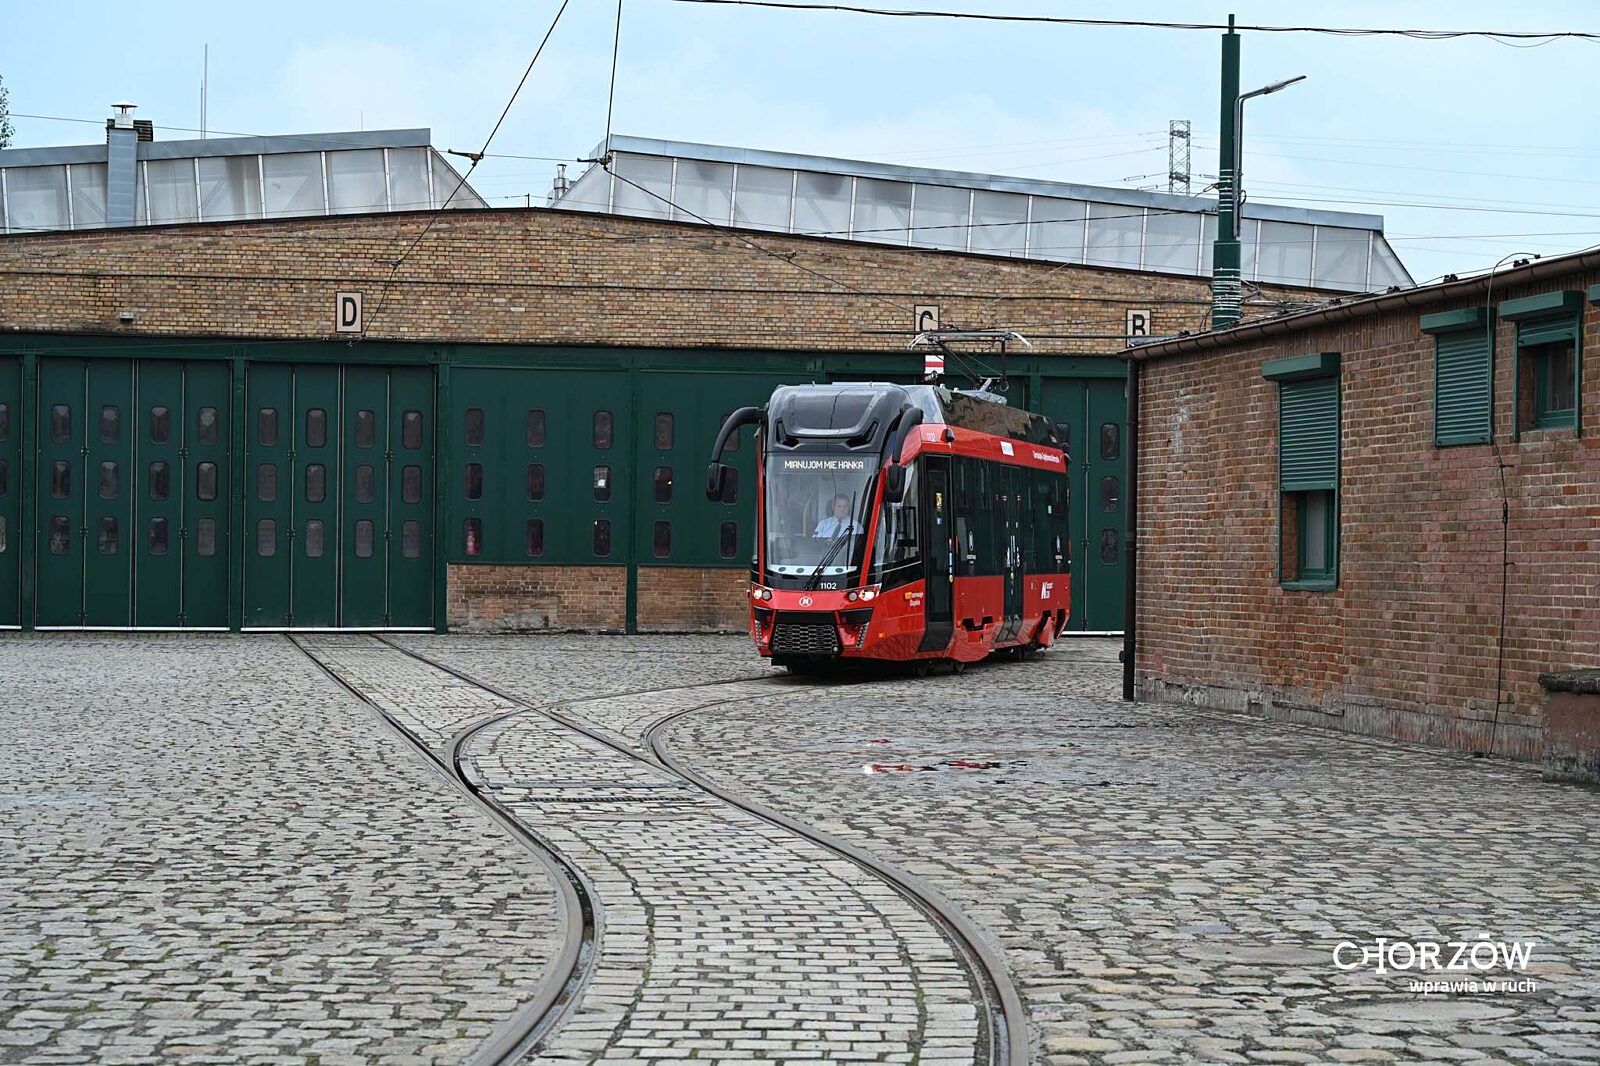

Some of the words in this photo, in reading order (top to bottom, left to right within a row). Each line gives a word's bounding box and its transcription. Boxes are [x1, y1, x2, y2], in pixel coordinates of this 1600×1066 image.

[342, 297, 357, 326] D
[784, 460, 823, 469] MIANUJOM
[824, 460, 837, 469] MIE
[838, 460, 864, 470] HANKA
[820, 582, 837, 590] 1102
